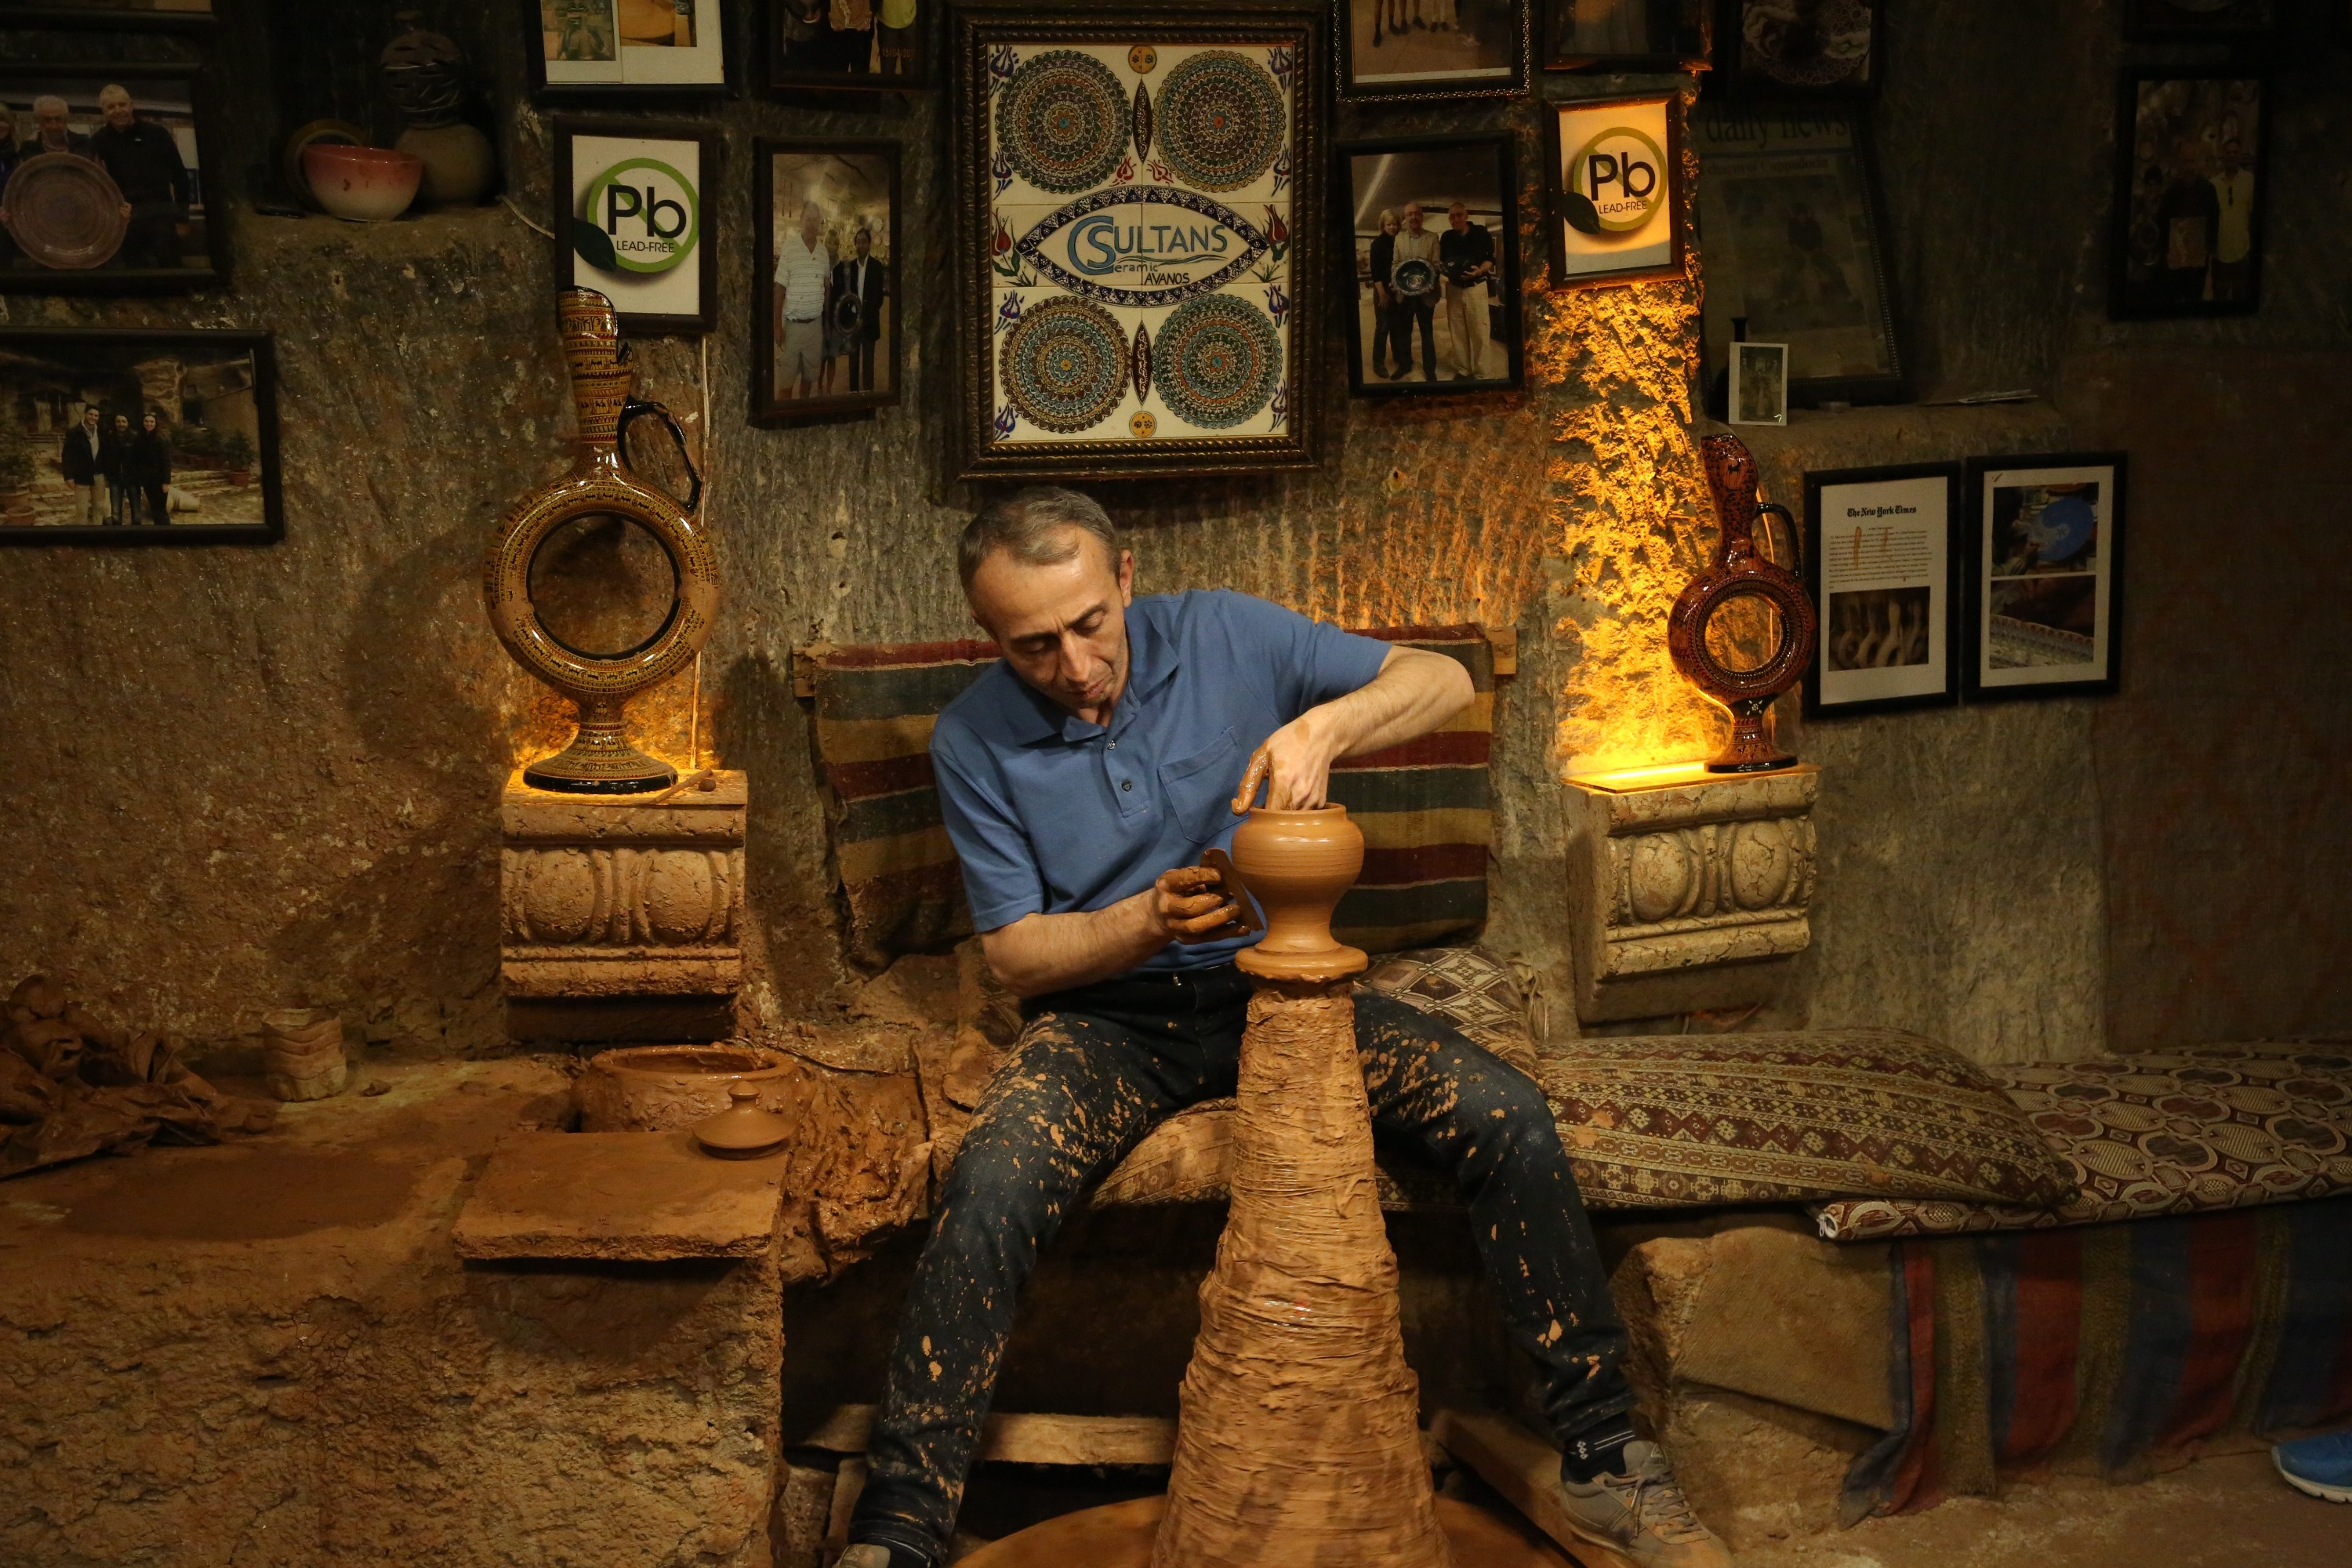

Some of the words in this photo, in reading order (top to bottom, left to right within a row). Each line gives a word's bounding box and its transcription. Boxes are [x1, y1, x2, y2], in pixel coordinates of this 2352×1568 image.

[1705, 103, 1769, 149] daily
[1780, 110, 1847, 139] news
[1589, 151, 1656, 201] Pb
[608, 184, 687, 238] Pb
[1599, 200, 1648, 214] LEAD-FREE
[616, 240, 675, 252] LEAD-FREE
[1087, 225, 1228, 268] SULTANS
[1145, 272, 1190, 285] AVANOS
[1847, 507, 1860, 517] The
[1860, 506, 1876, 517] New
[1877, 506, 1894, 517] York
[1895, 505, 1917, 514] Times
